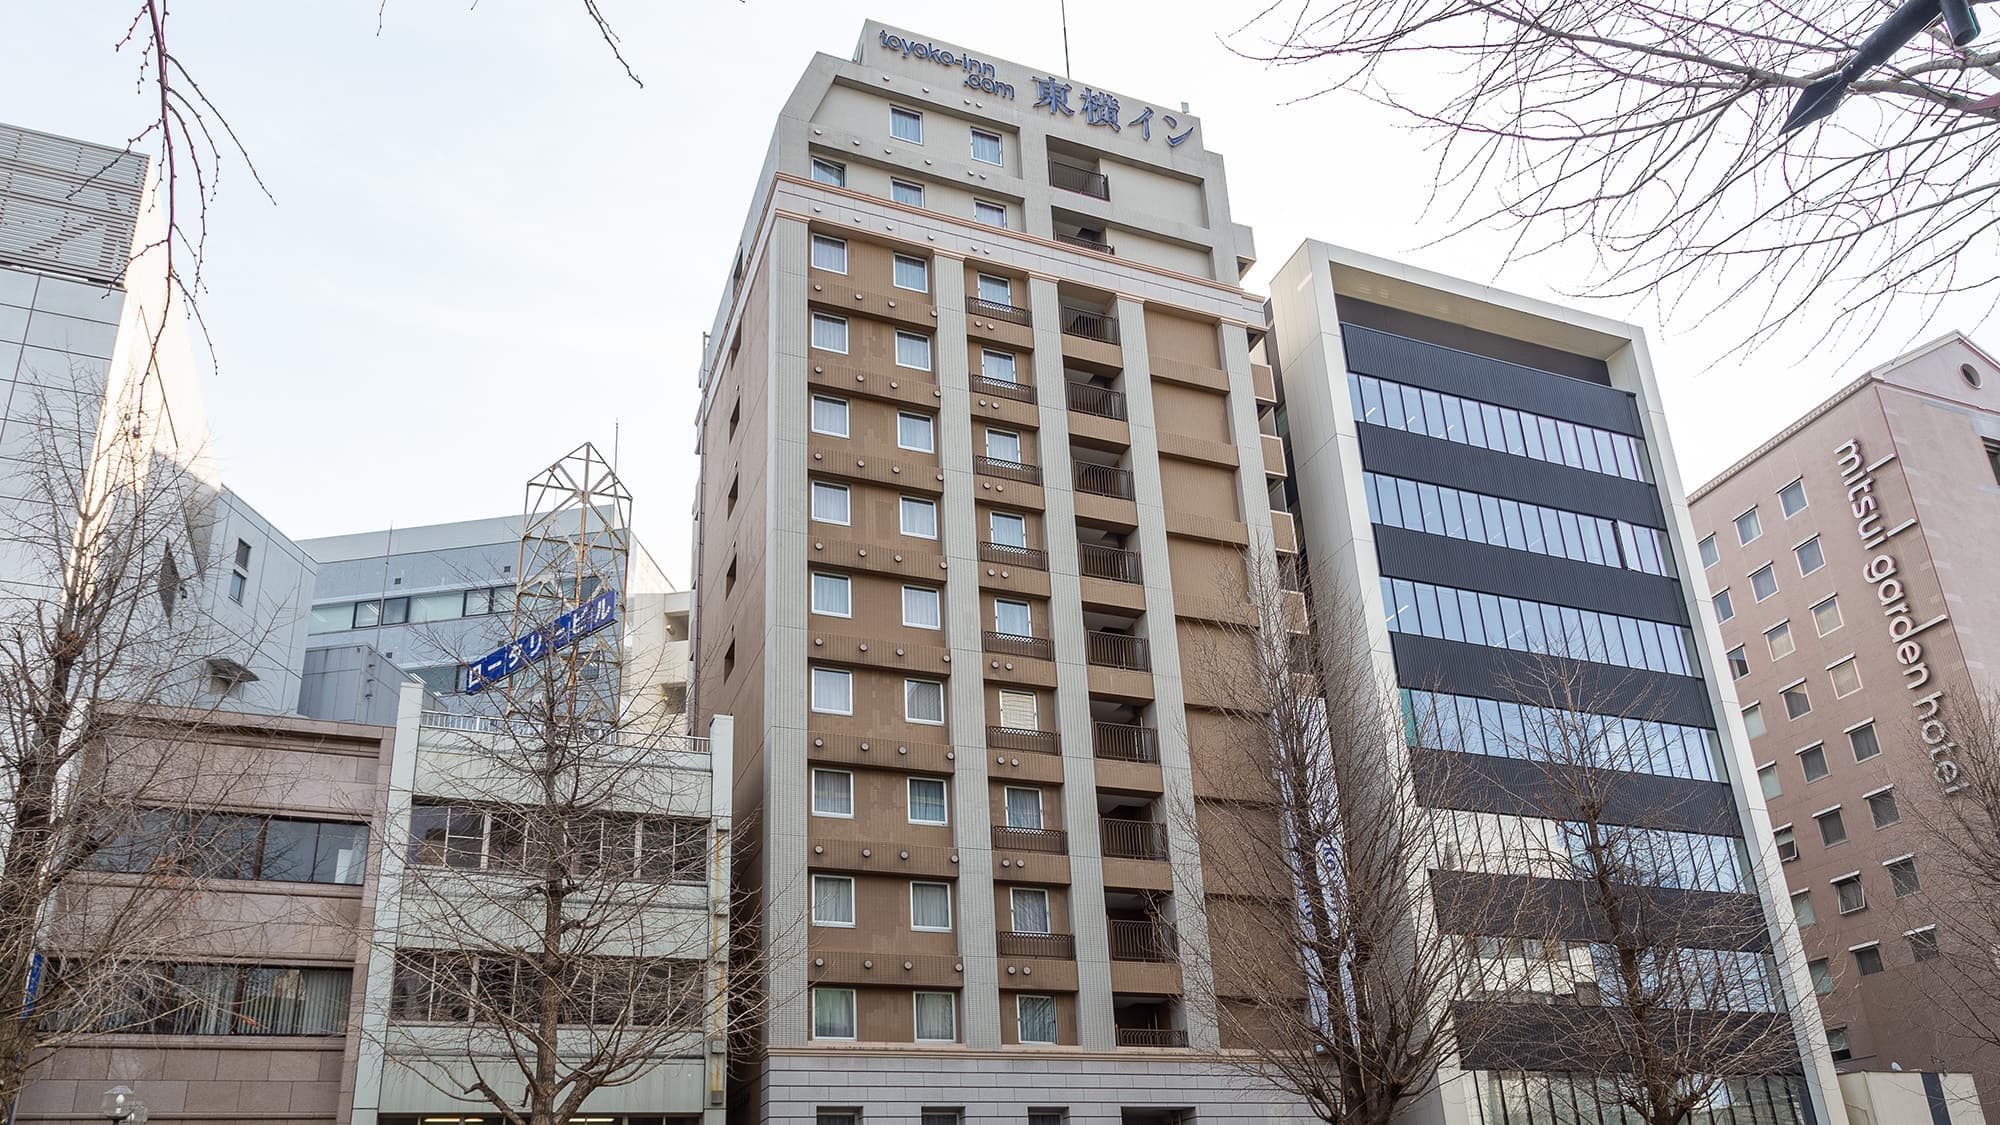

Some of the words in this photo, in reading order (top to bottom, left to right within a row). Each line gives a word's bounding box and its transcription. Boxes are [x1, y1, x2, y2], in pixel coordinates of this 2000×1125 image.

[879, 29, 996, 78] toyoko-inn
[963, 72, 1015, 101] .com
[1031, 75, 1194, 147] 東横イン
[1833, 437, 1917, 550] mitsui
[1863, 554, 1949, 690] garden
[1912, 690, 1970, 795] hotel
